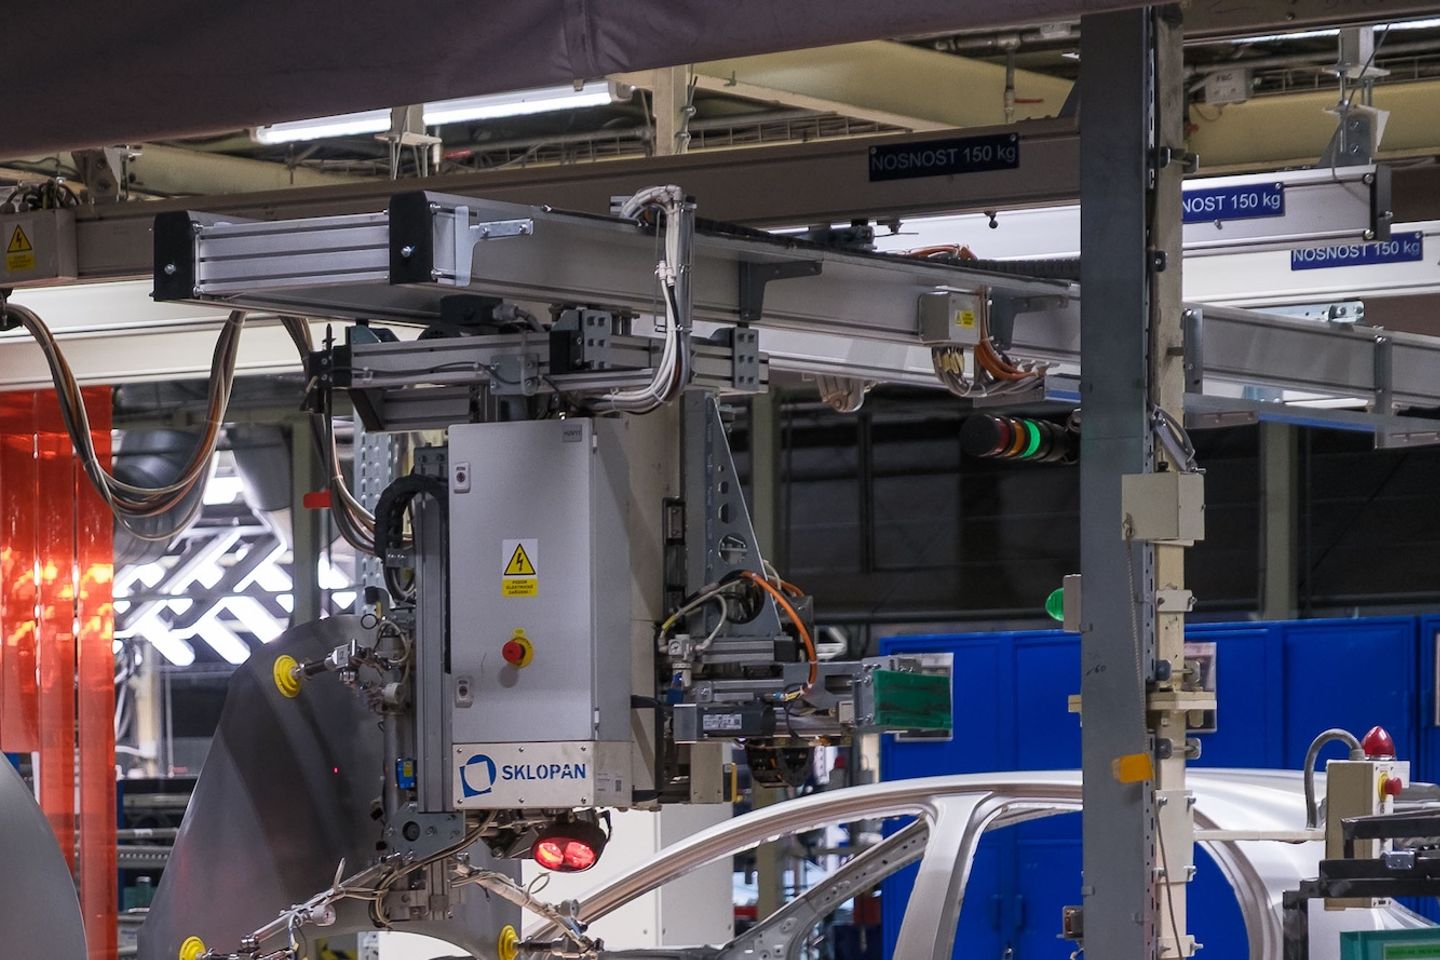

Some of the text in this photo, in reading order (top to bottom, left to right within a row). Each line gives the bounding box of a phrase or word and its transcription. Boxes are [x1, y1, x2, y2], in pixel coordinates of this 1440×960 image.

[872, 144, 1015, 171] NOSNOST 150 kg
[1231, 193, 1258, 209] 150
[1263, 192, 1281, 209] kg
[1293, 240, 1420, 262] NOSNOST 150 kg
[502, 763, 586, 780] SKLOPAN
